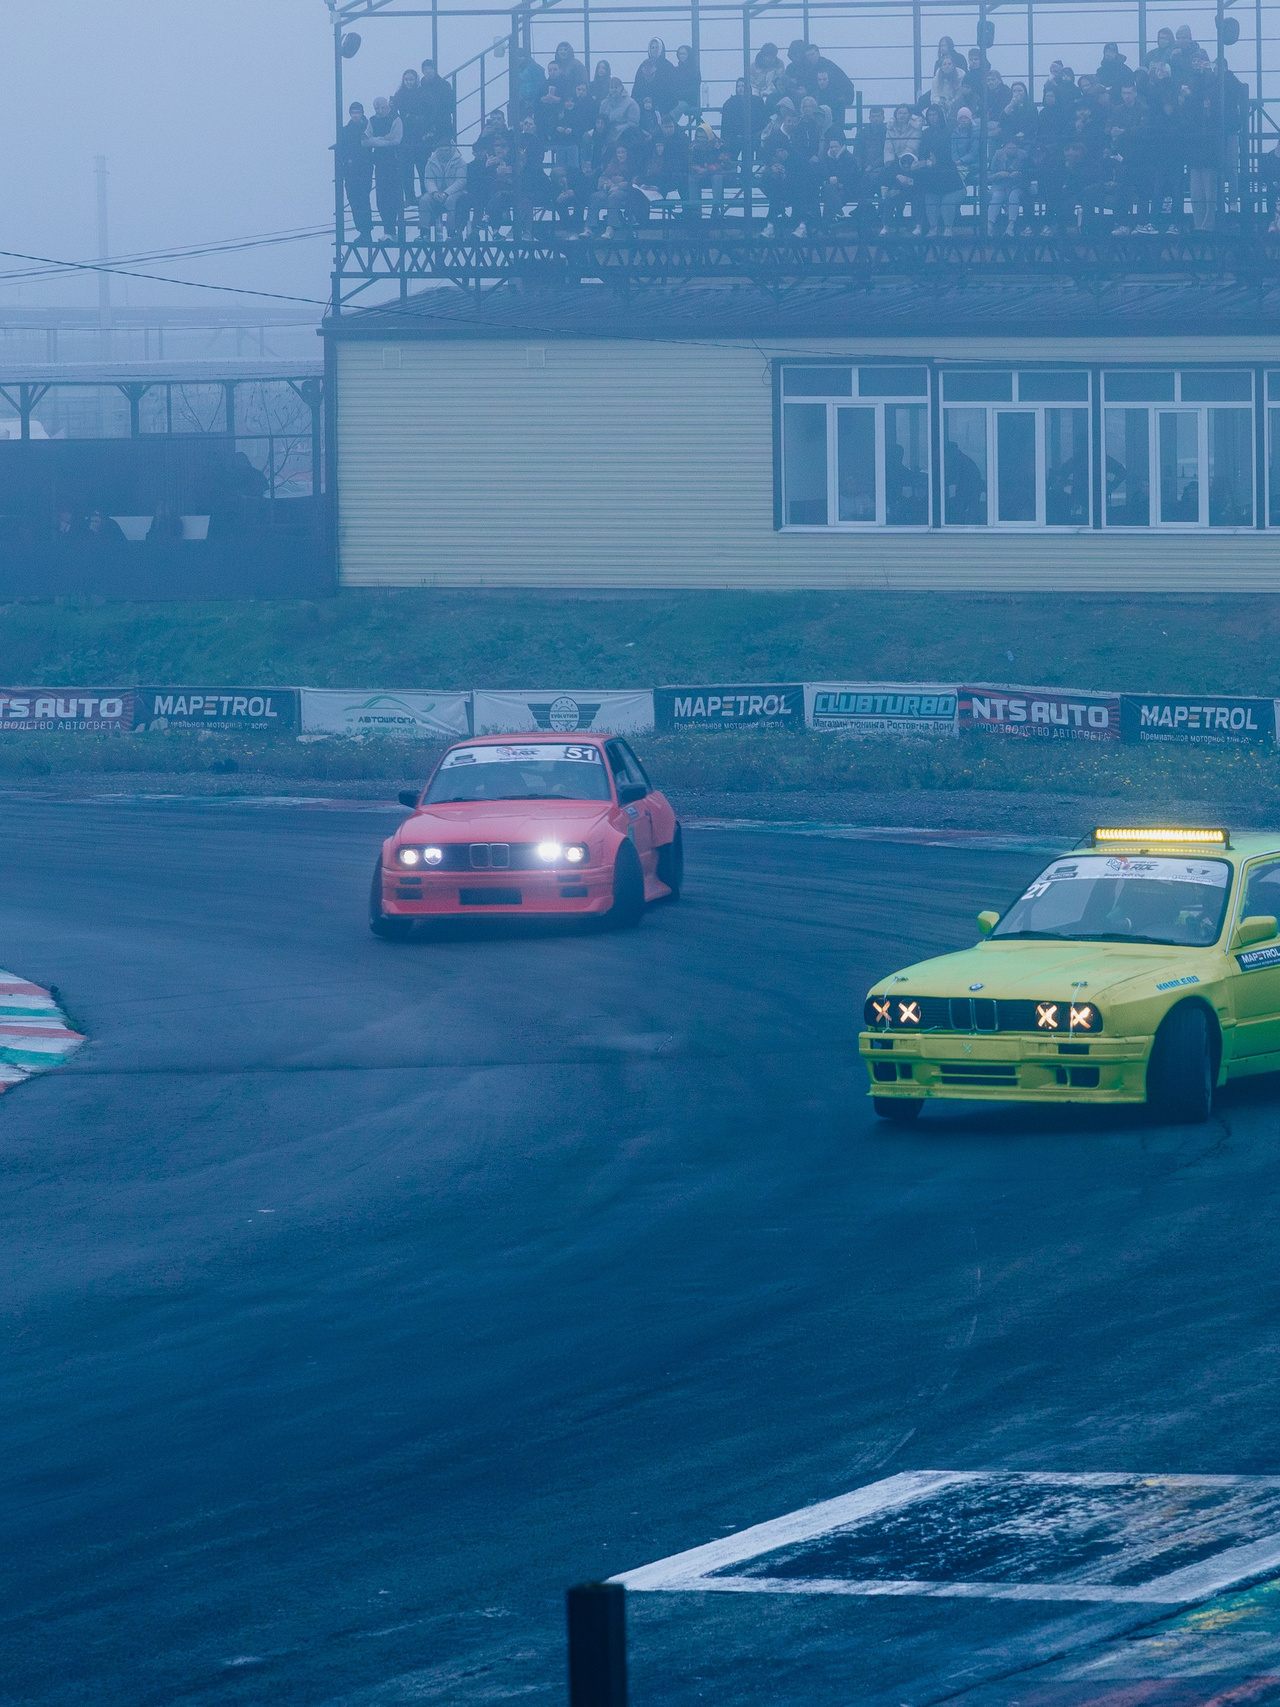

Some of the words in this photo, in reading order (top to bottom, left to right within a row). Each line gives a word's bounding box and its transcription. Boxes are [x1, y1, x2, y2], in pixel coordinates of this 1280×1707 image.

[35, 698, 123, 718] AUTO
[153, 695, 278, 717] MAPETROL
[673, 694, 793, 718] MAPETROL
[815, 693, 957, 719] CLUBTURBO
[971, 697, 1028, 722] NTS
[1031, 701, 1110, 728] AUTO
[57, 721, 121, 731] АВТОСВЕТА
[1140, 705, 1258, 730] MAPETROL
[566, 747, 594, 761] 51
[1020, 881, 1052, 901] 21
